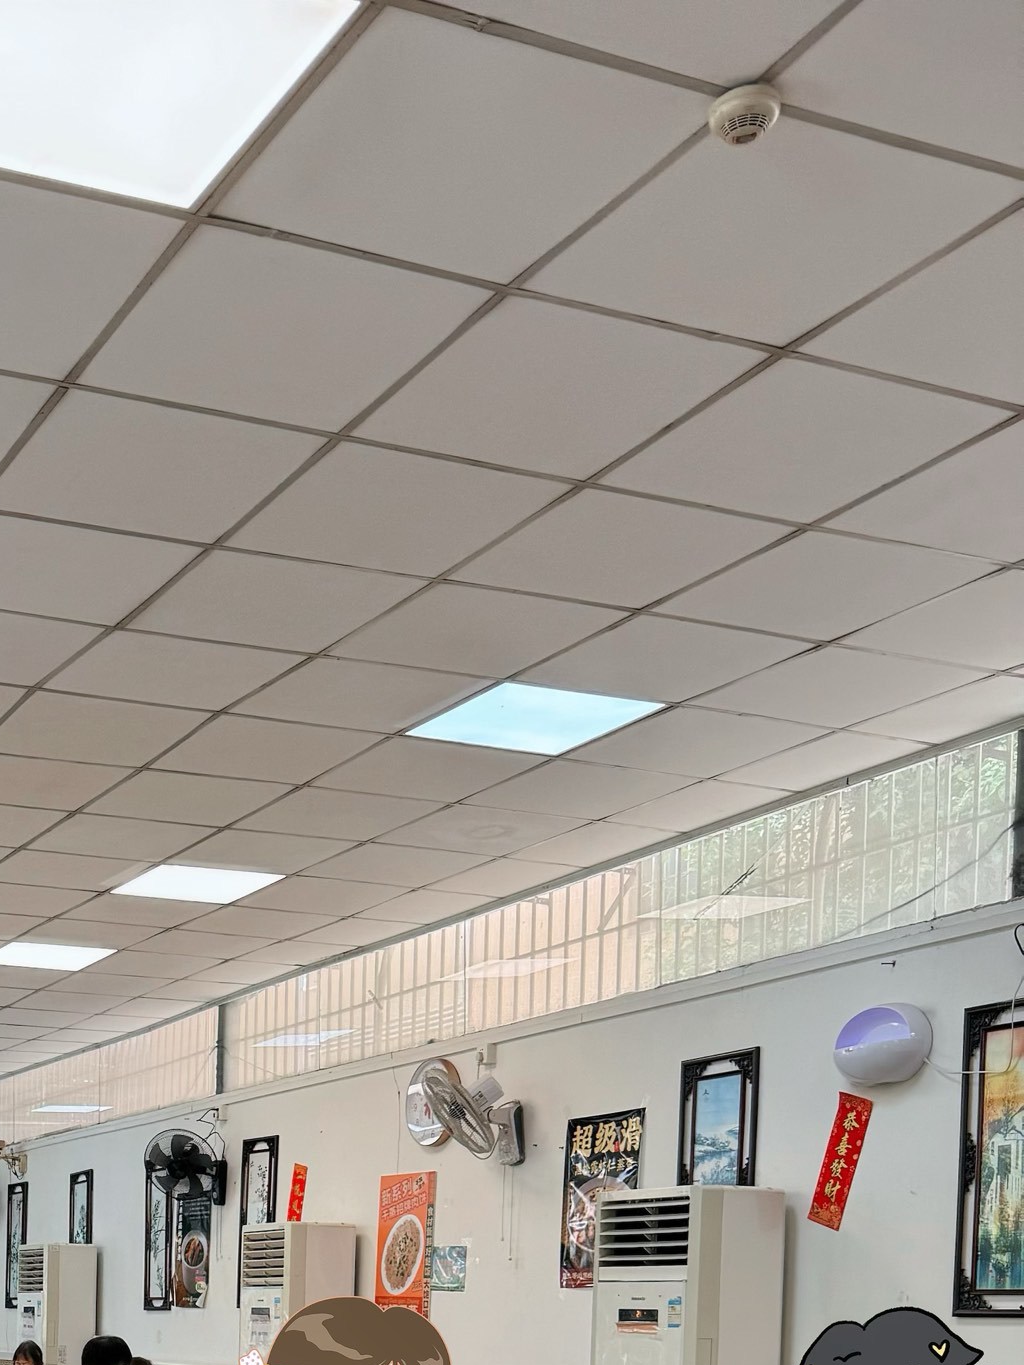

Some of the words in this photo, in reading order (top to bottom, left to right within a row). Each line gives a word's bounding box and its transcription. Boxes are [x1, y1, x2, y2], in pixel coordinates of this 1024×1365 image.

[571, 1116, 642, 1157] 超级滑
[824, 1109, 859, 1202] 恭喜發財
[381, 1177, 413, 1206] 新系列
